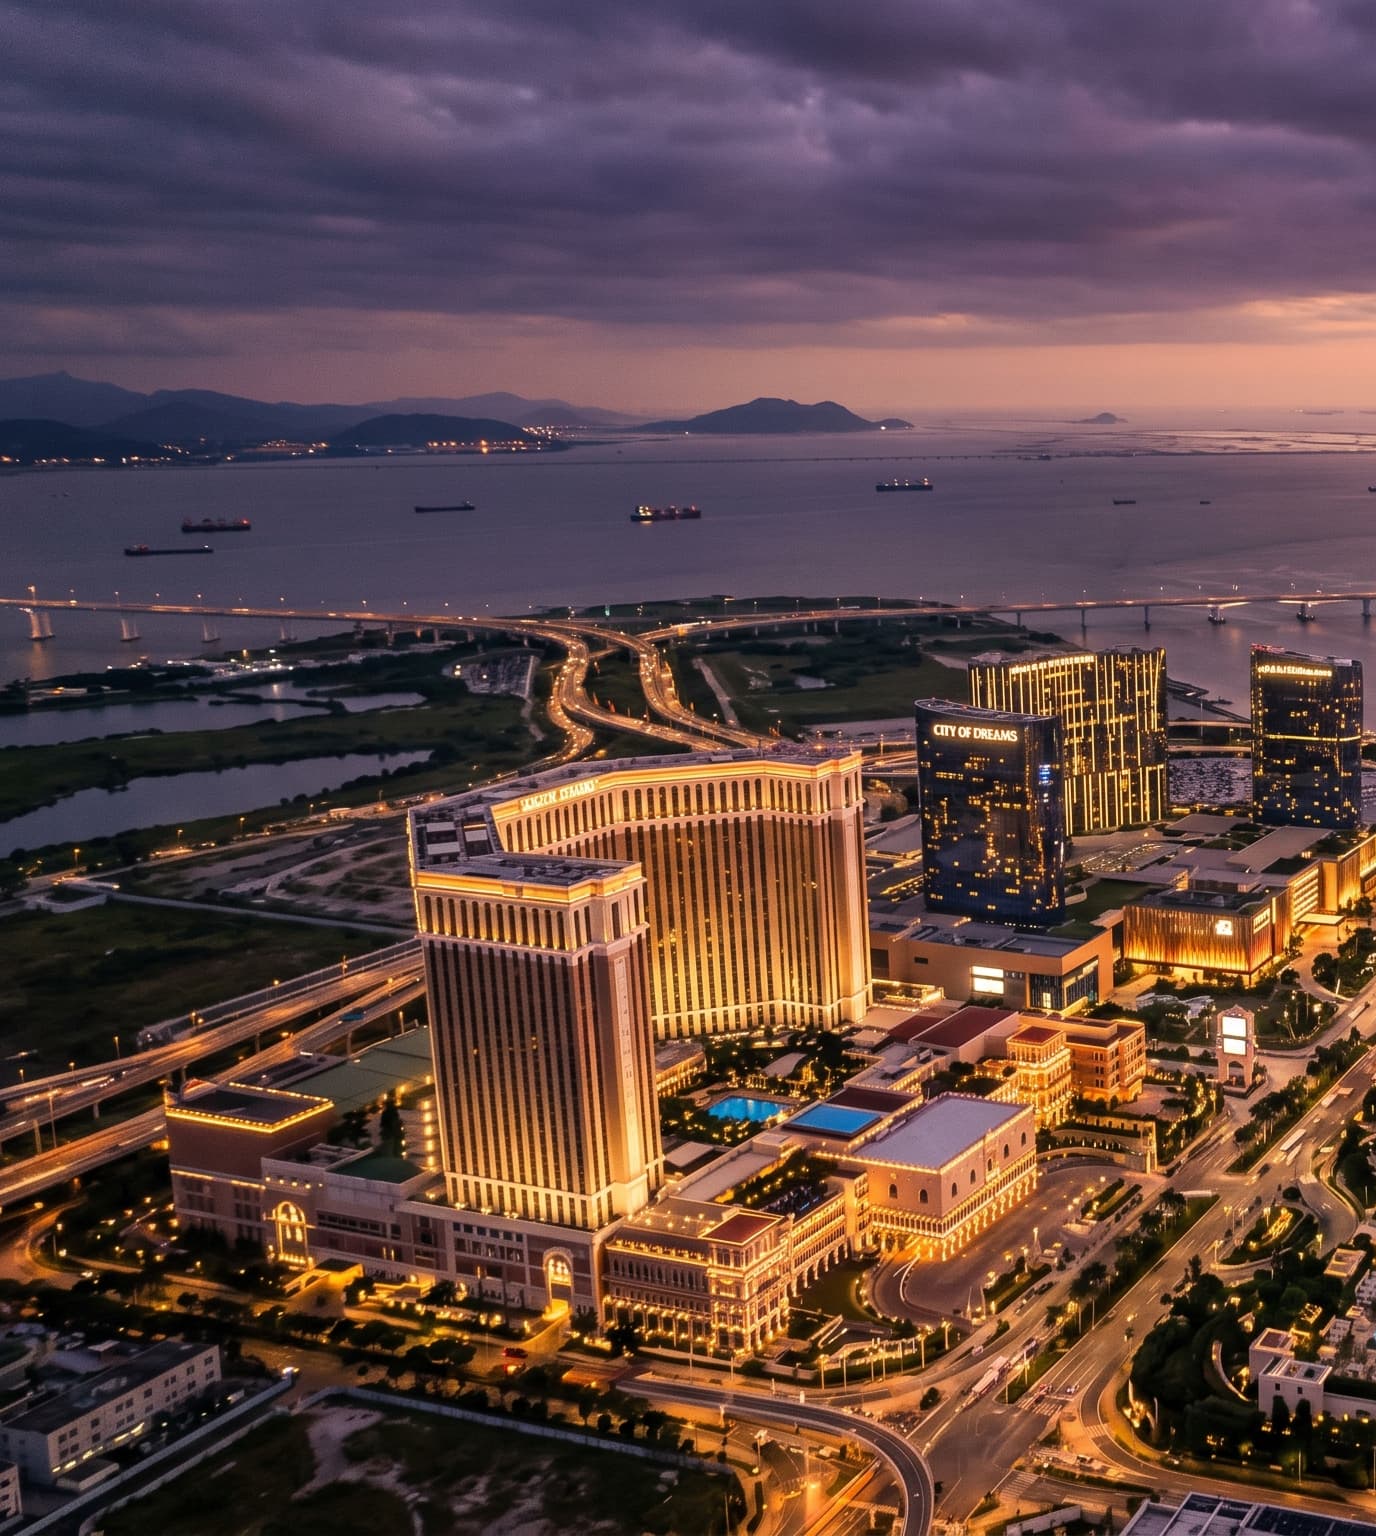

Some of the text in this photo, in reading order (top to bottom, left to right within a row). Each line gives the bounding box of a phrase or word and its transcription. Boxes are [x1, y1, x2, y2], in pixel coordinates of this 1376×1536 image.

[933, 724, 1018, 742] CITY OF DREAMS
